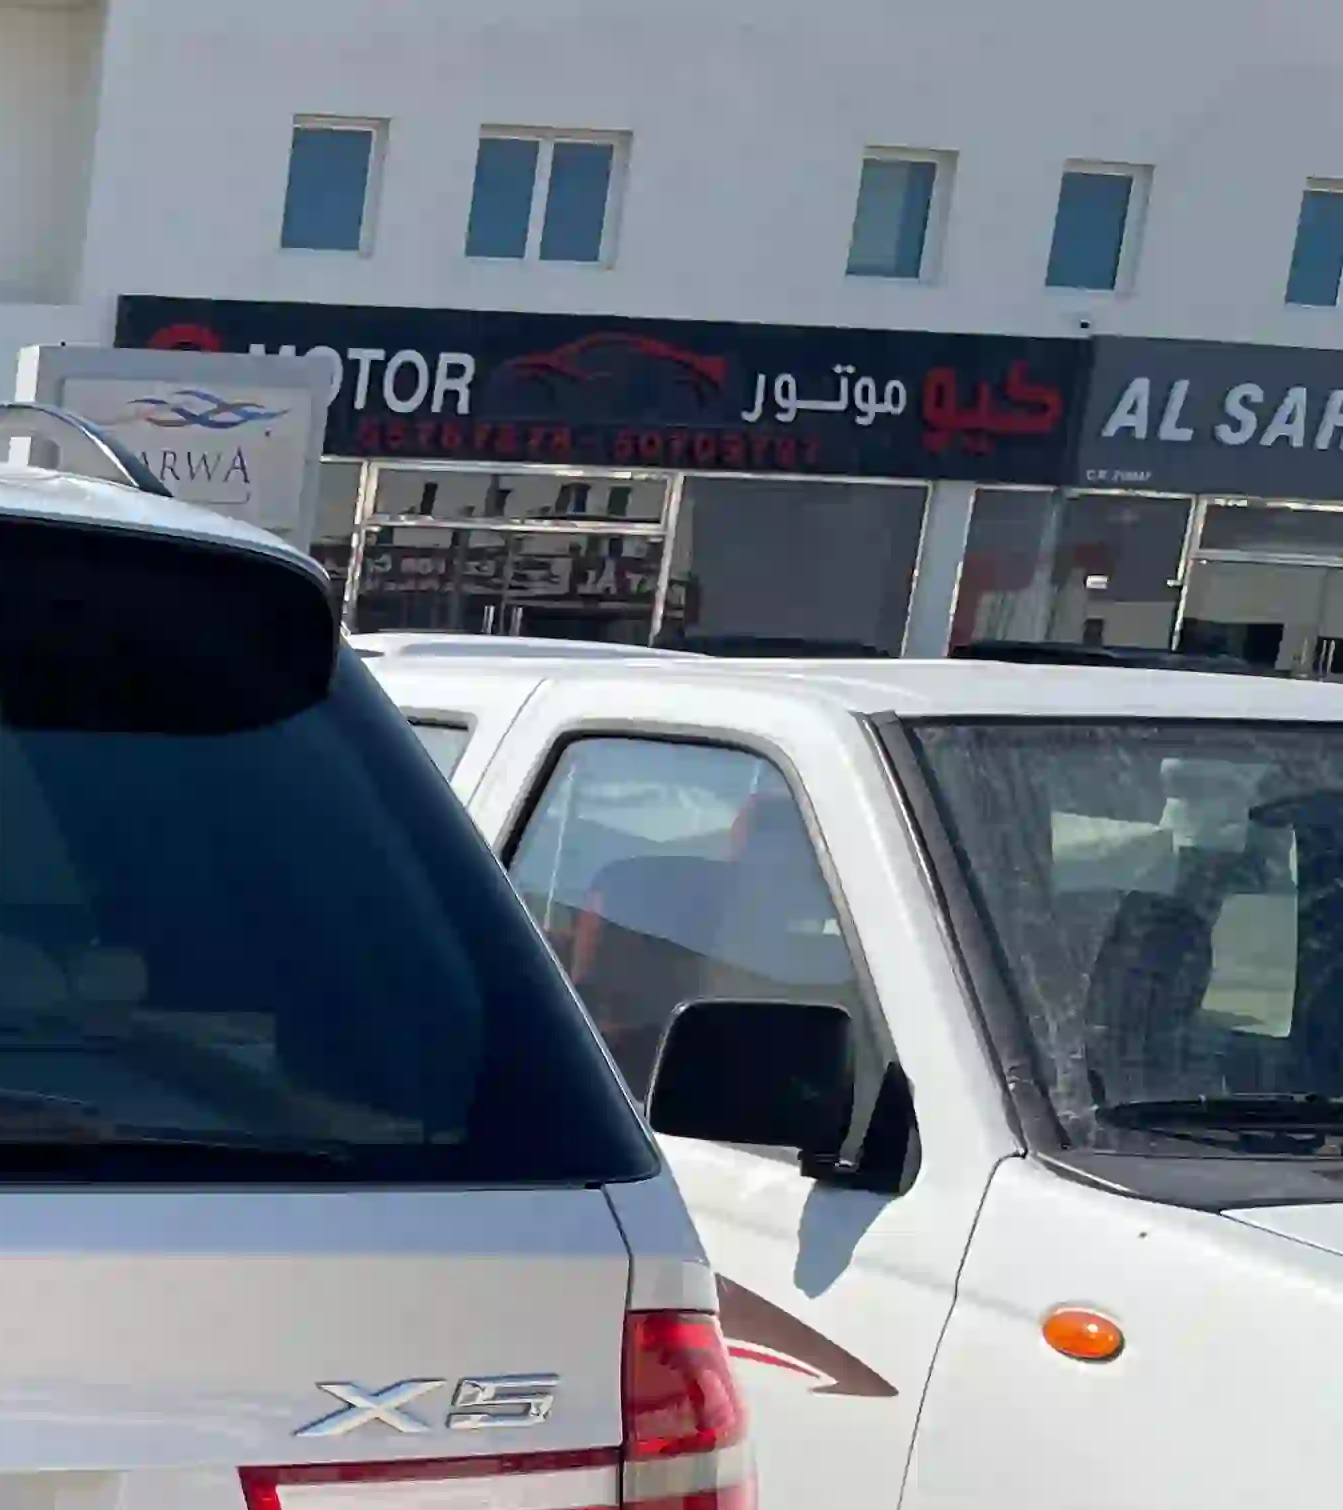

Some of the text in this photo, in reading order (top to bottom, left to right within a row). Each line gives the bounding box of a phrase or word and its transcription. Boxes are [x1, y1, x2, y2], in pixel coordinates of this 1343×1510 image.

[248, 342, 476, 416] OTOR
[921, 359, 1063, 457] كيو
[1100, 376, 1195, 442] AL
[289, 1372, 561, 1438] X5
